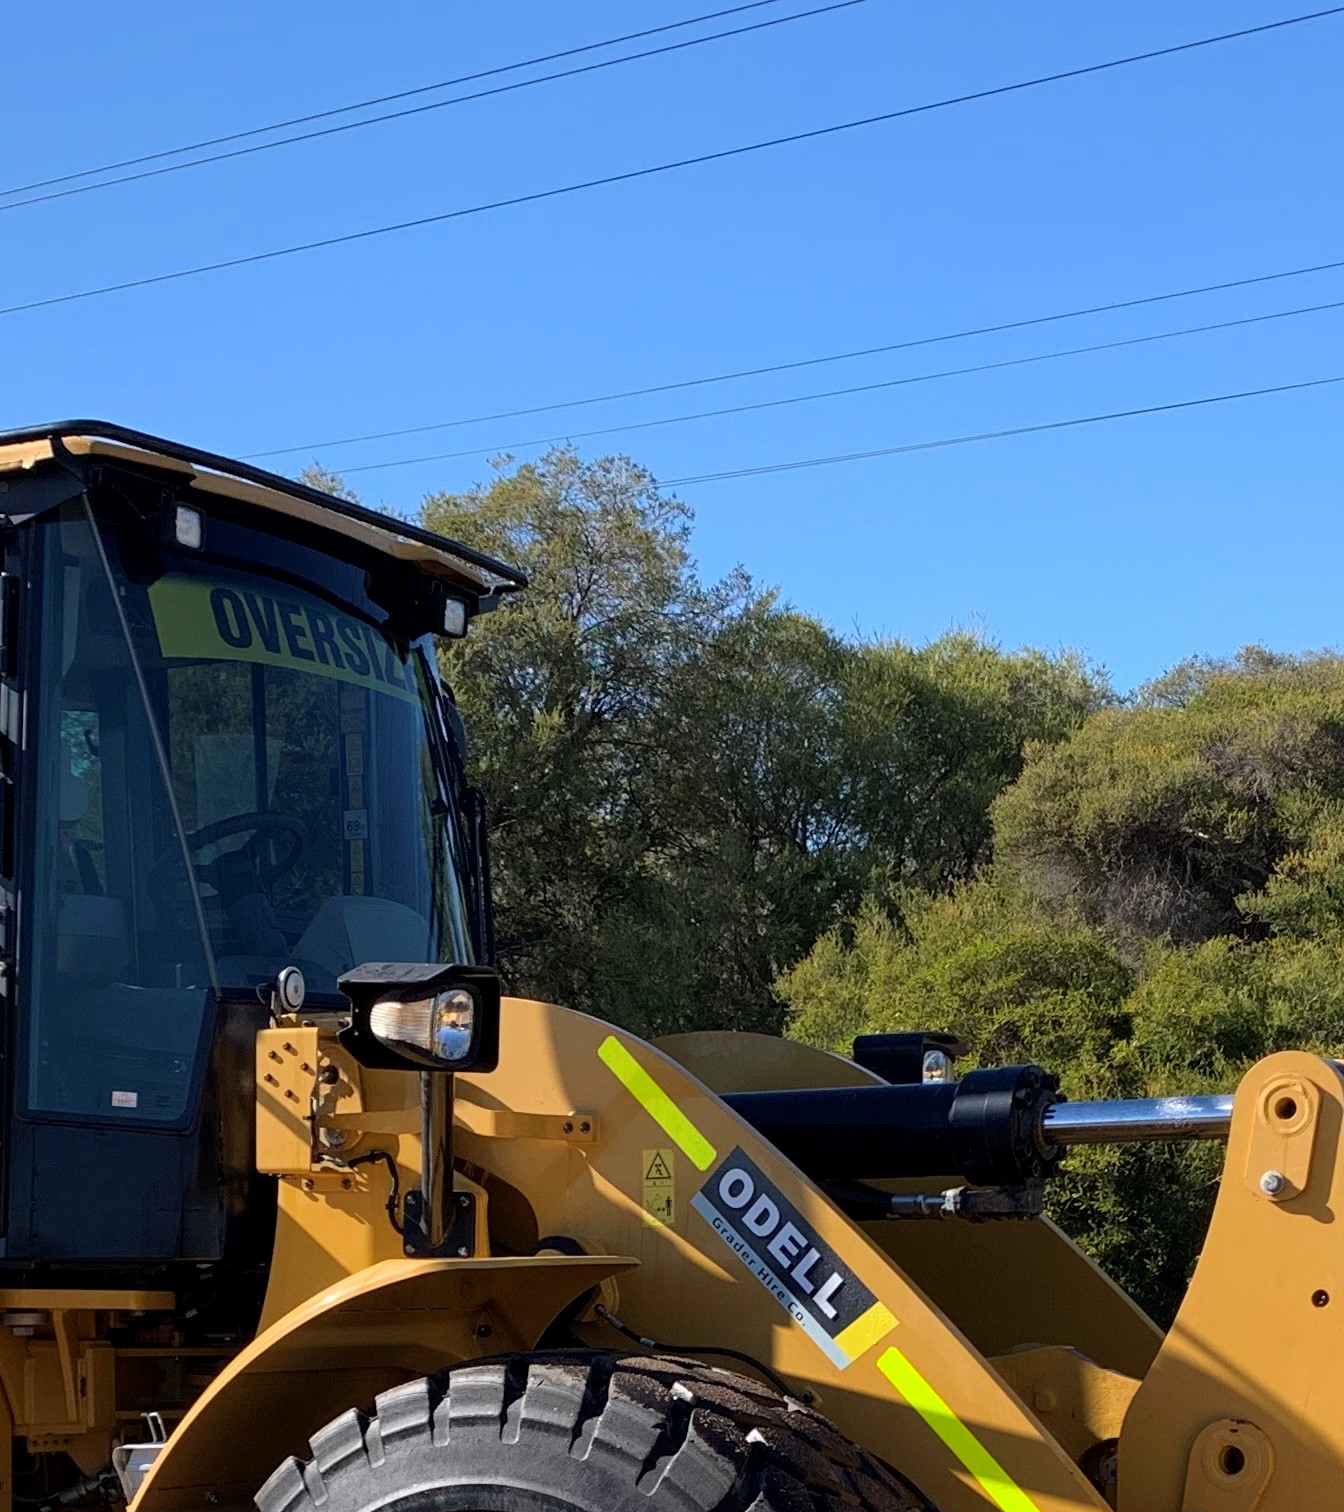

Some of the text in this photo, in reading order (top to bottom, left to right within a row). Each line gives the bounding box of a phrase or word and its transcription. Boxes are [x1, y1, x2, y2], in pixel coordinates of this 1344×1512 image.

[210, 587, 416, 694] OVERSIZ
[712, 1217, 807, 1327] Grader Hire Co.
[718, 1168, 844, 1320] ODELL
